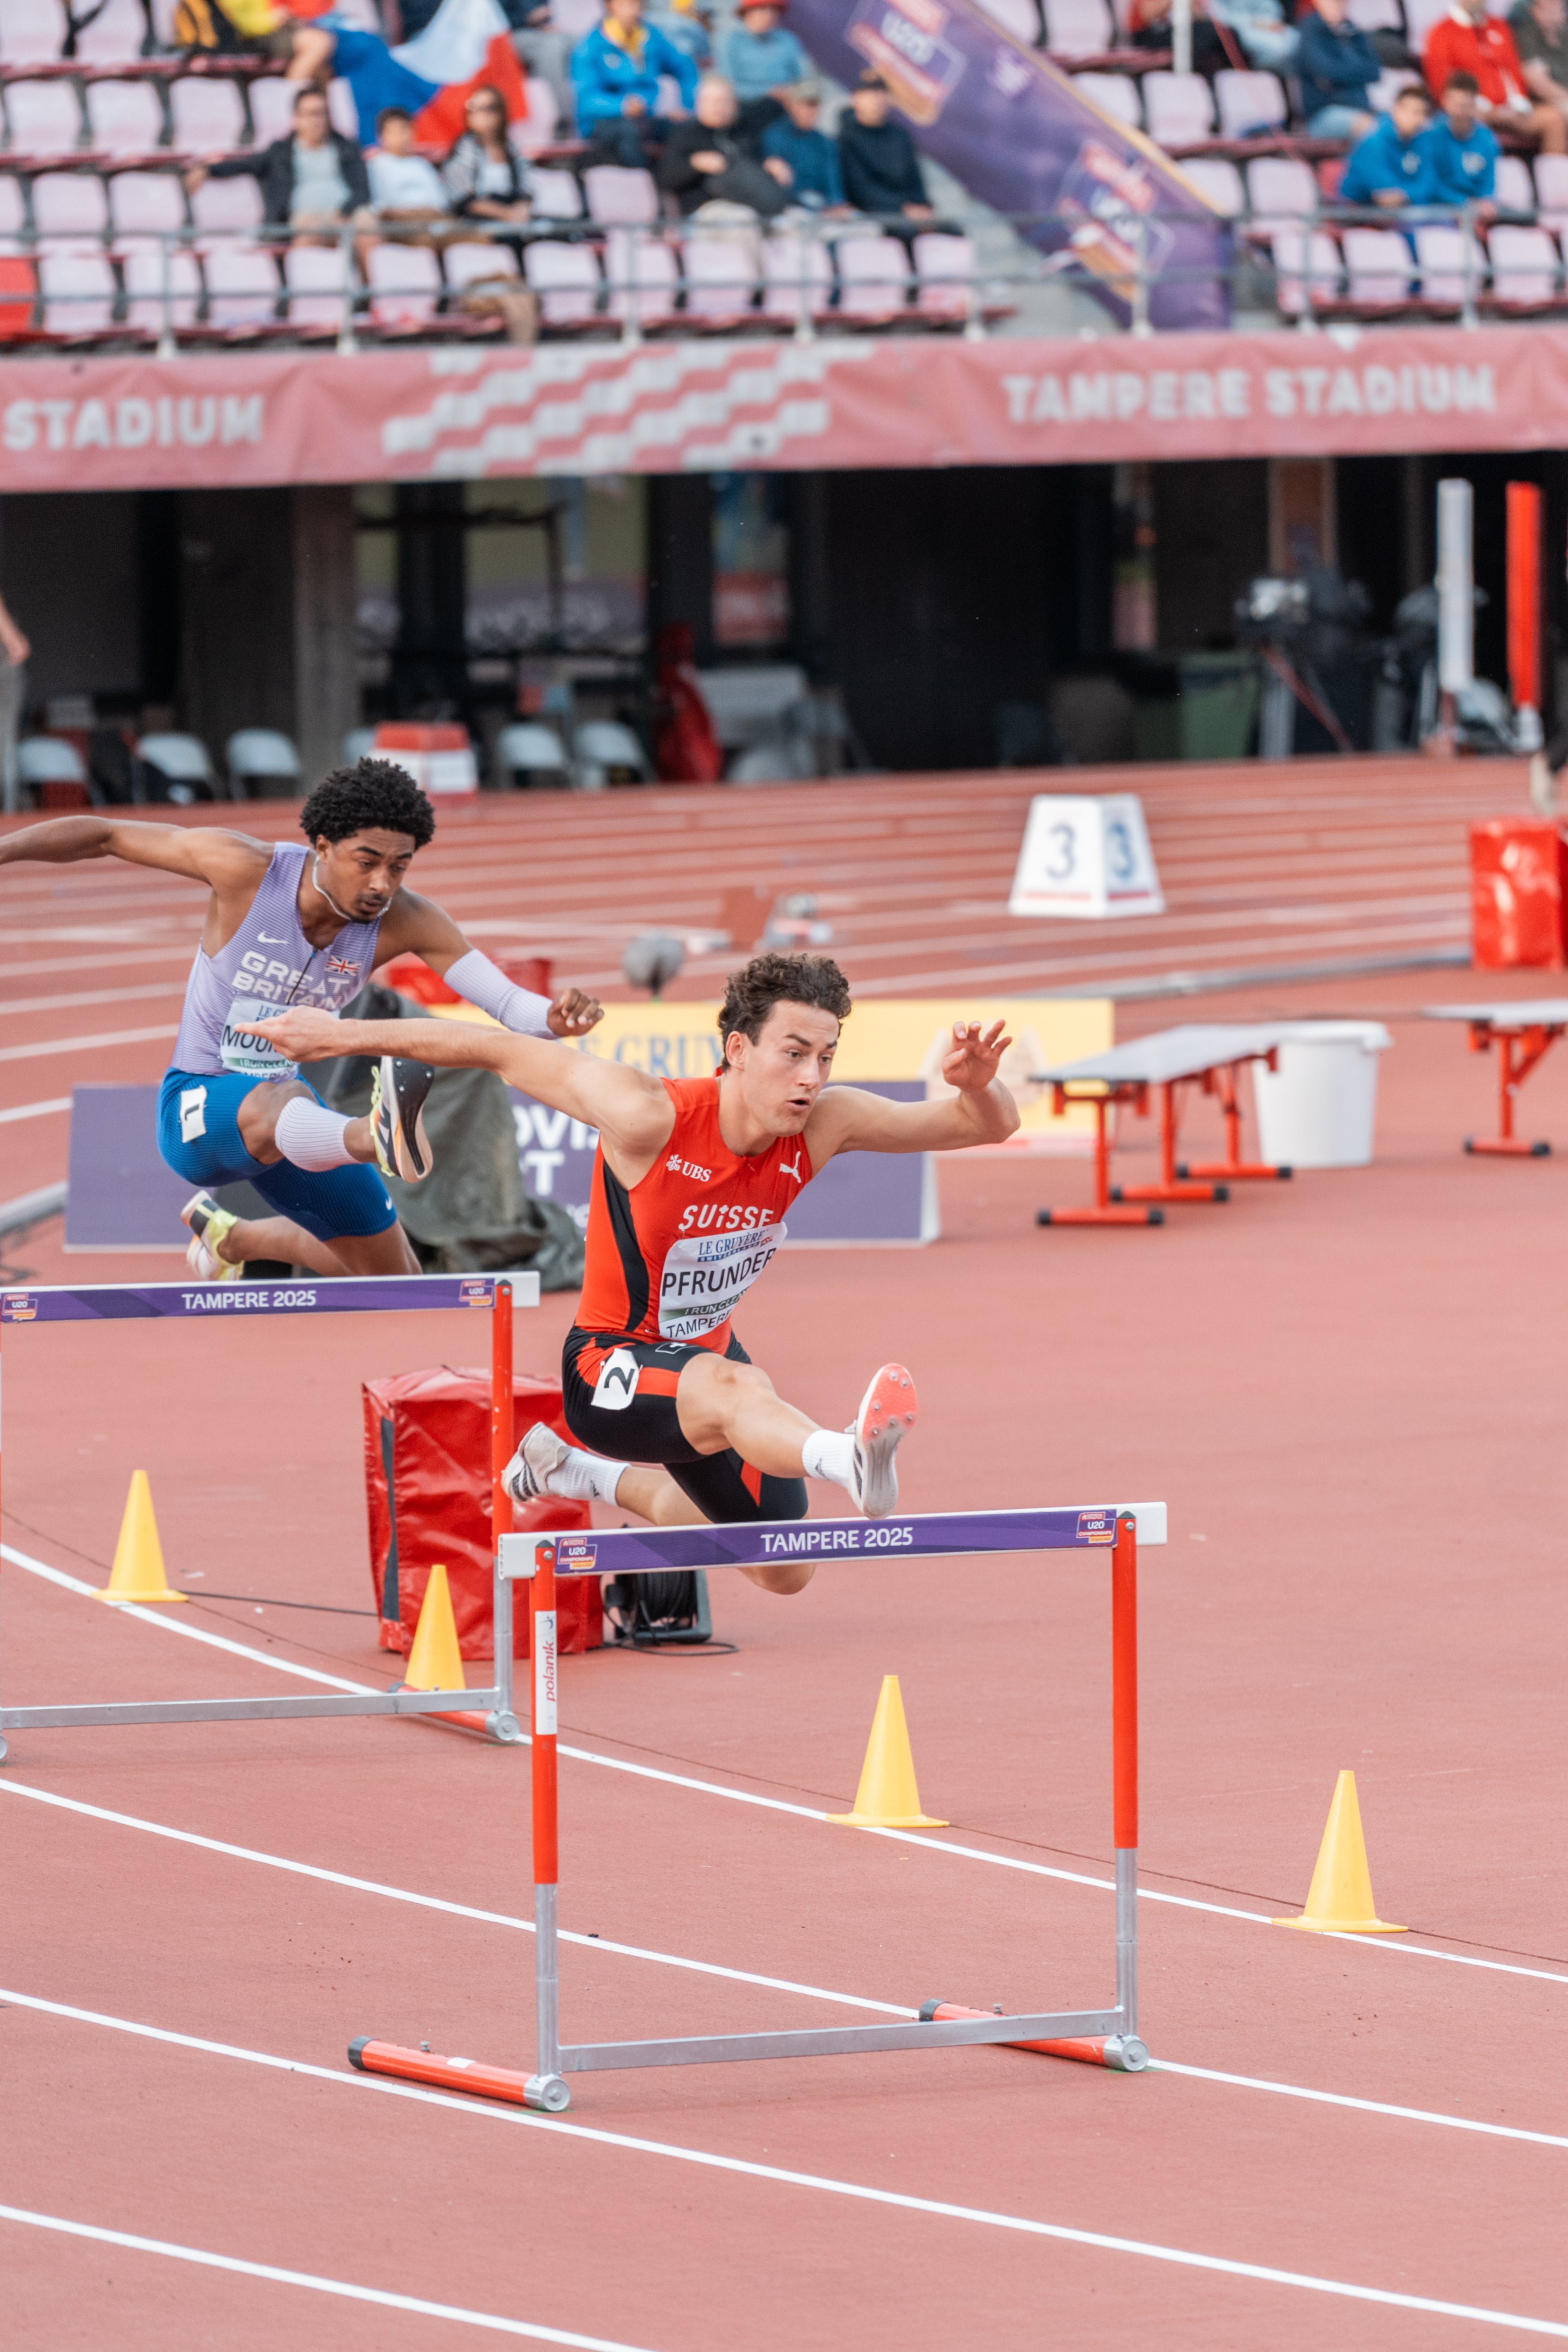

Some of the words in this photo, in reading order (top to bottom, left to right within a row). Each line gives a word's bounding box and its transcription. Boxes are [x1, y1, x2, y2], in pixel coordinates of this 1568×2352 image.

[1003, 367, 1252, 424] TAMPERE
[1263, 362, 1496, 417] STADIUM
[3, 394, 266, 452] STADIUM
[1045, 821, 1078, 881] 3
[241, 950, 350, 994] GREAT
[231, 970, 344, 1010] BRITAIN
[682, 1161, 712, 1182] UBS
[698, 1240, 712, 1256] LE
[715, 1230, 765, 1253] GRUYÈRE
[700, 1241, 759, 1262] SWITZERLAND
[181, 1291, 270, 1309] TAMPERE
[273, 1290, 317, 1308] 2025
[690, 1304, 718, 1314] RUN
[603, 1367, 635, 1395] 2
[1087, 1520, 1105, 1530] U20
[568, 1546, 586, 1556] U20
[760, 1530, 860, 1553] TAMPERE
[864, 1527, 913, 1548] 2025
[541, 1640, 556, 1702] polanik
